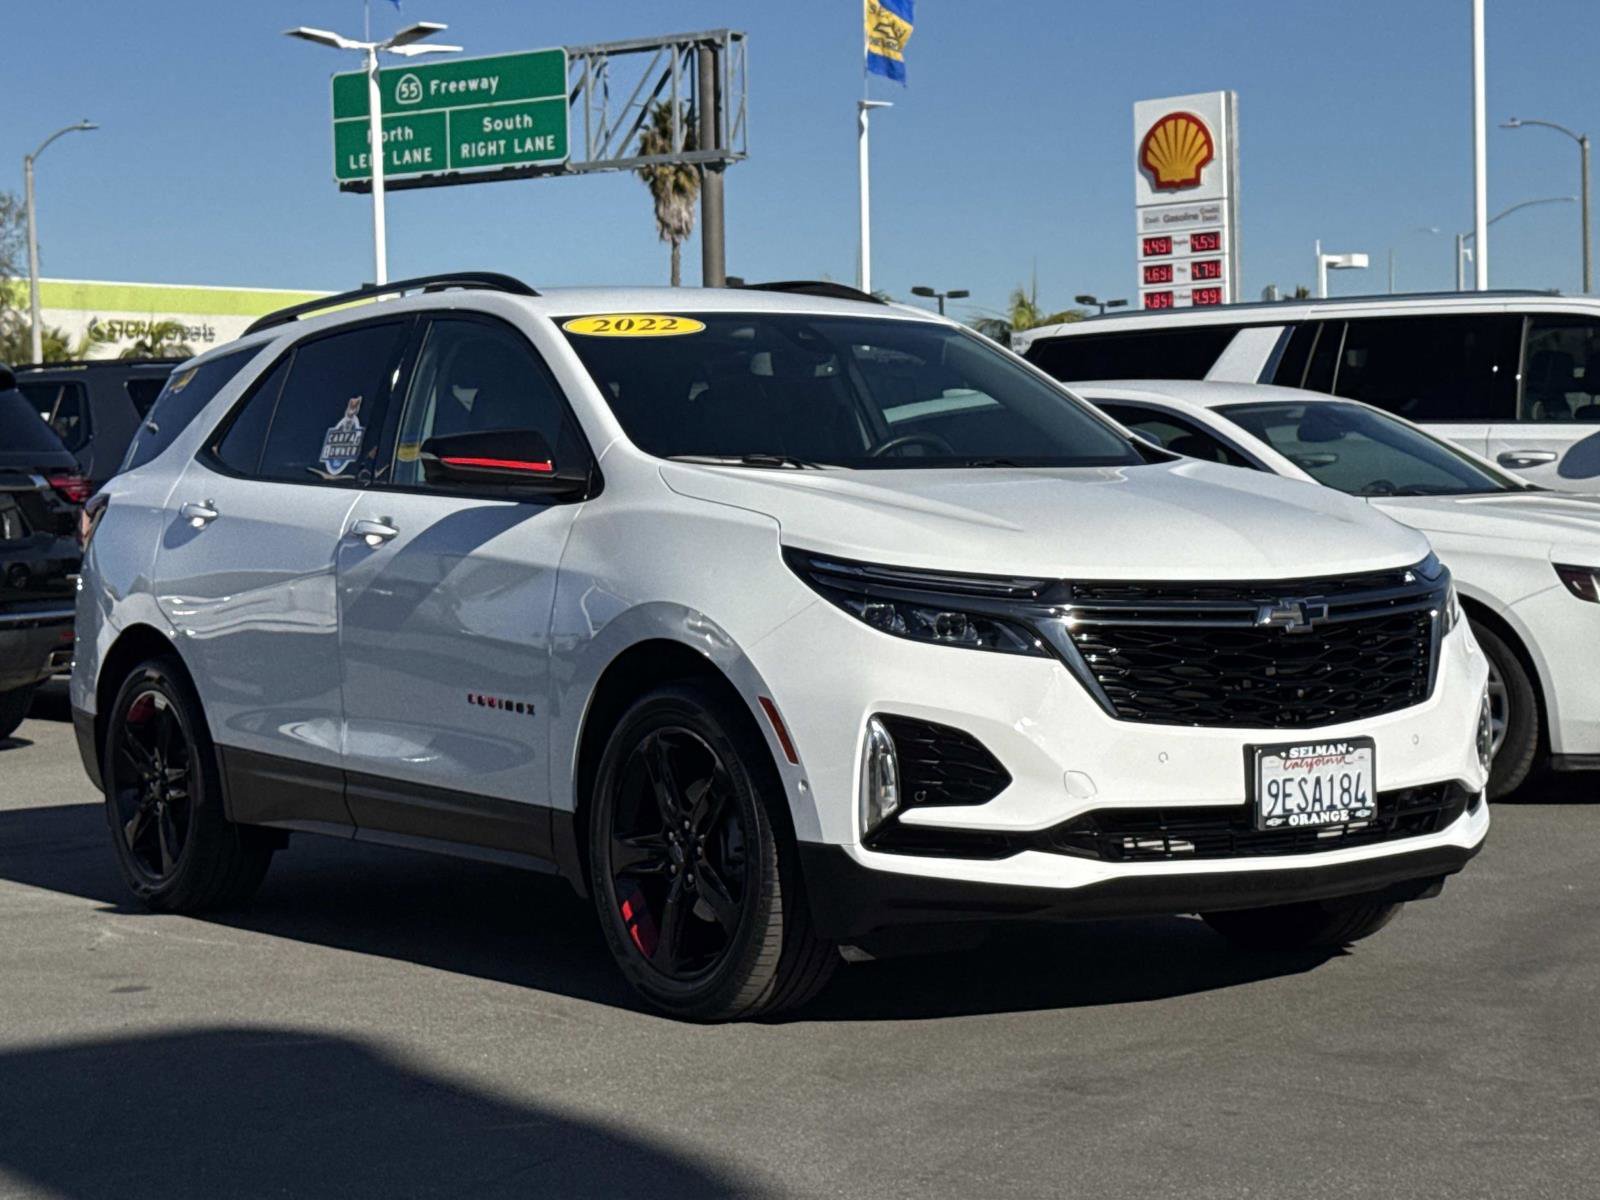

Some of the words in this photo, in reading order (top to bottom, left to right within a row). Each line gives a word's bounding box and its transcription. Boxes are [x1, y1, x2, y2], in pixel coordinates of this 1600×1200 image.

[401, 82, 418, 98] 55
[430, 75, 499, 96] Freeway
[483, 113, 533, 132] South
[461, 140, 506, 158] RIGHT
[514, 135, 556, 154] LANE
[349, 153, 385, 170] LE
[393, 147, 432, 165] LANE
[592, 318, 678, 333] 2022
[1289, 742, 1348, 758] SELMAN
[1282, 754, 1353, 774] California
[1266, 771, 1367, 816] 9ESA184
[1288, 809, 1350, 826] ORANGE
